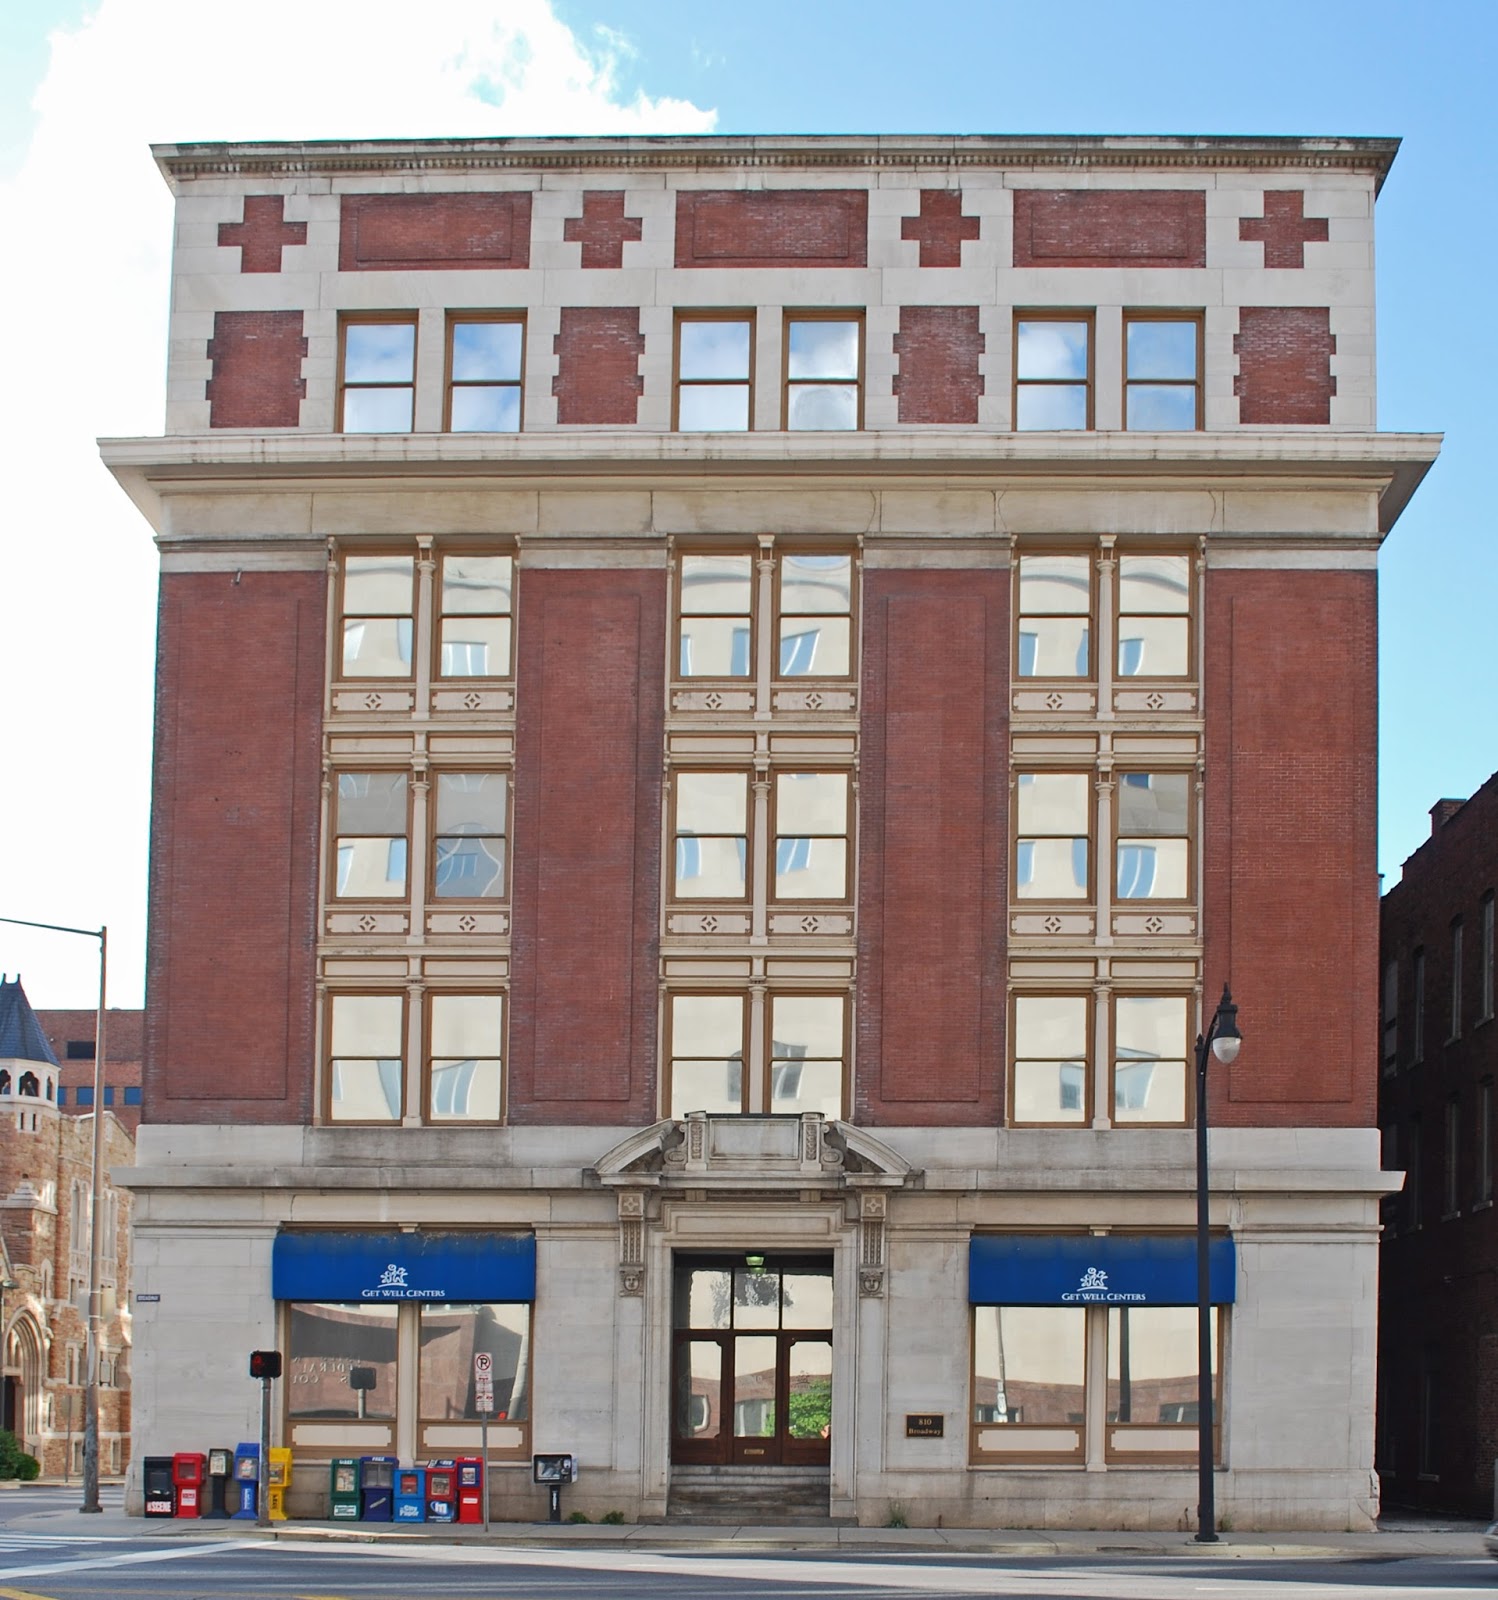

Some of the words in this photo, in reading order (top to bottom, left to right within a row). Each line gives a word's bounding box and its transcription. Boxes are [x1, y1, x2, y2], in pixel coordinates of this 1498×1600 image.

[361, 1289, 381, 1297] GET
[382, 1289, 405, 1297] WELL
[406, 1289, 446, 1297] CENTERS
[1061, 1292, 1081, 1300] GET
[1106, 1292, 1146, 1300] CENTERS
[151, 1500, 172, 1513] SCENE
